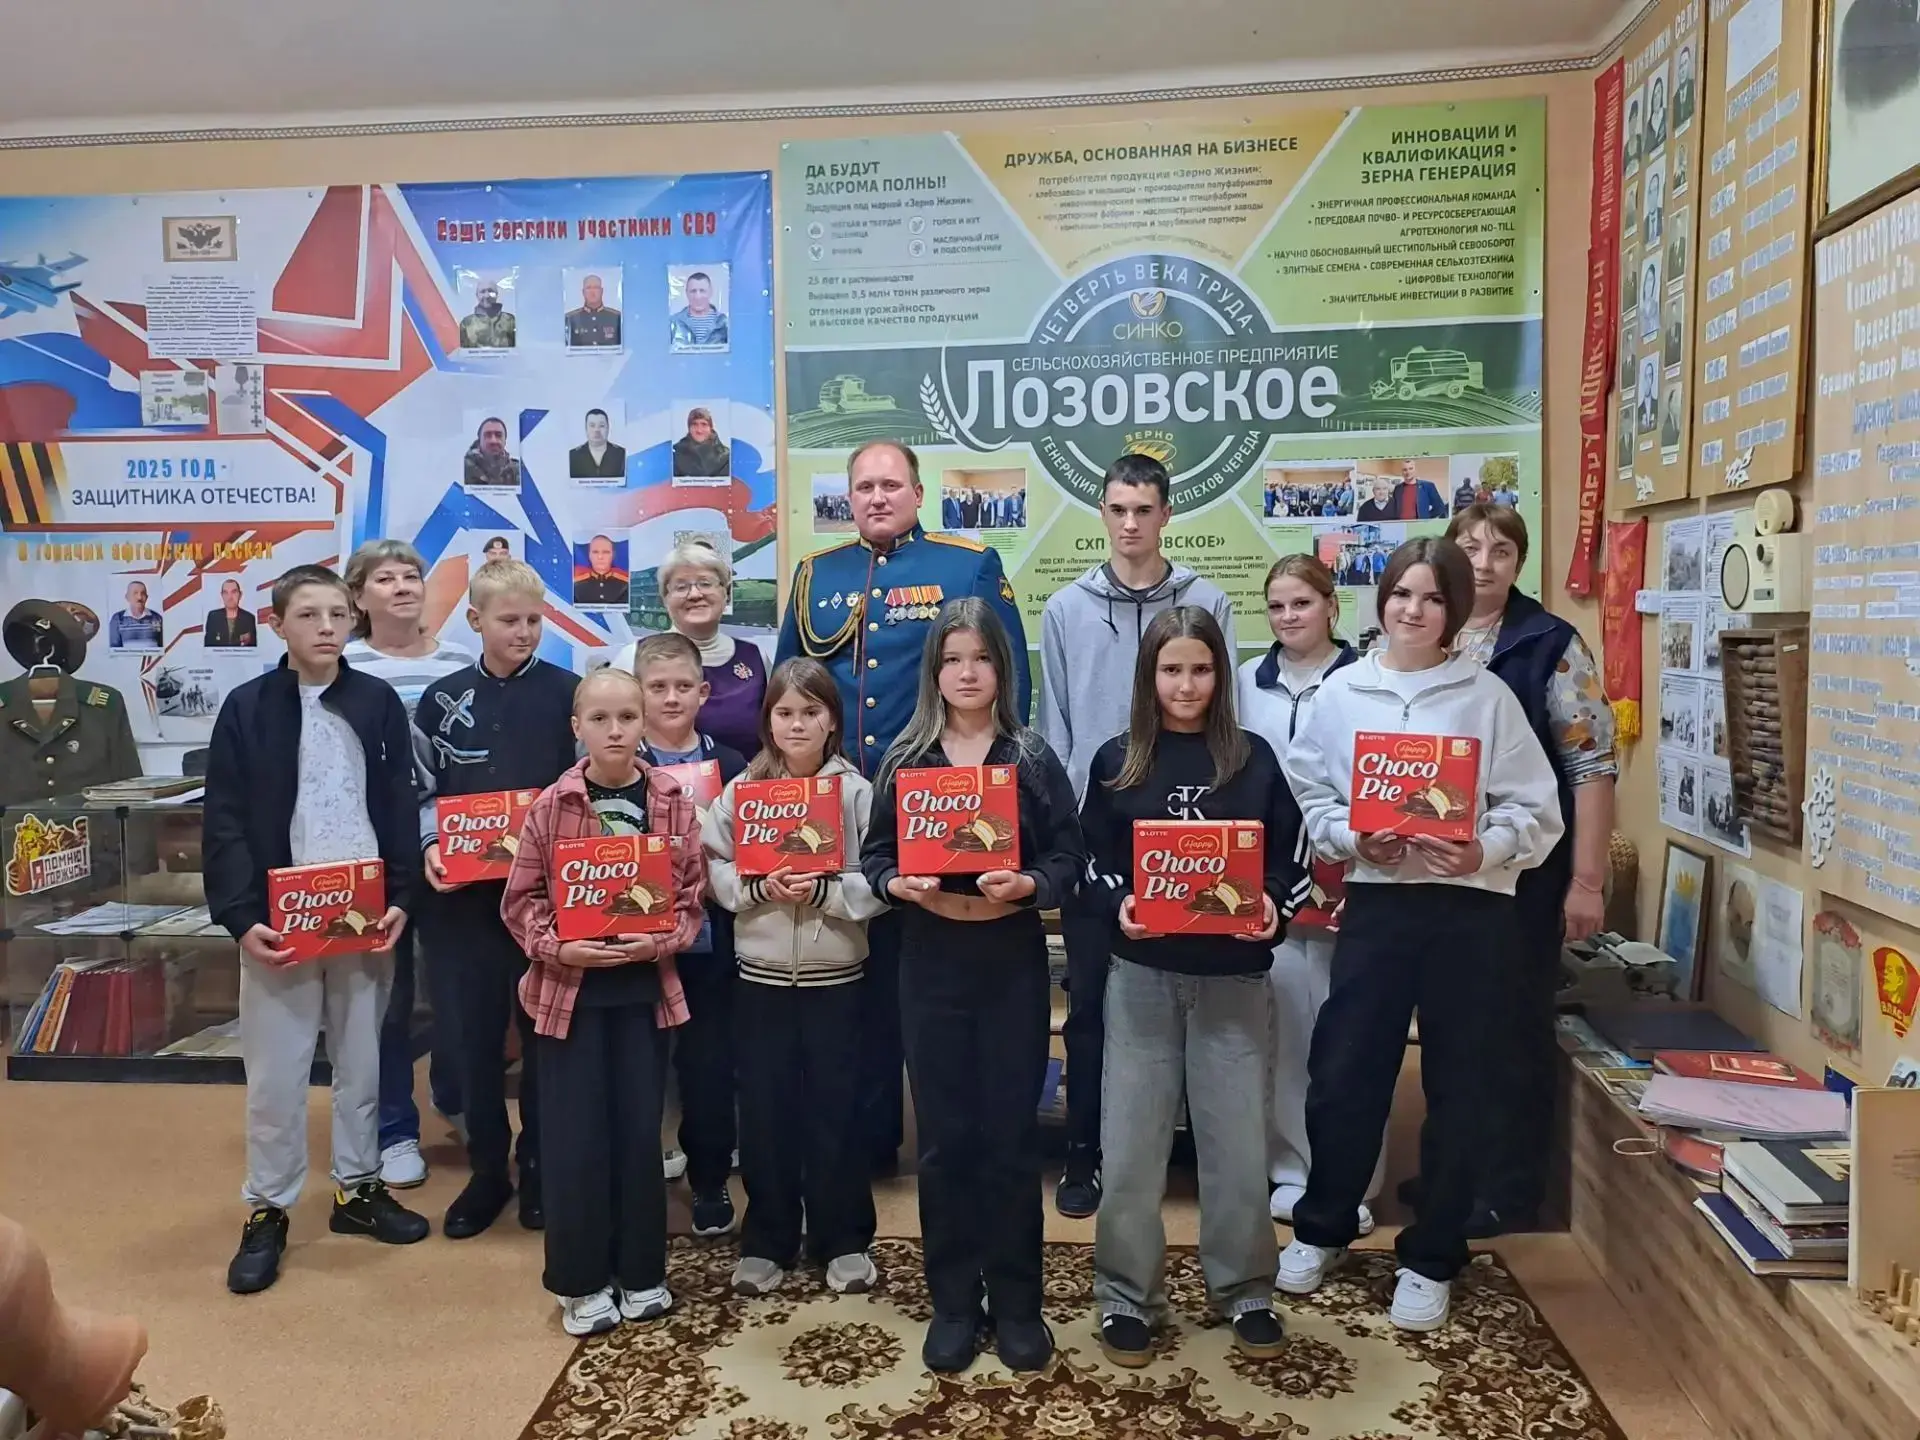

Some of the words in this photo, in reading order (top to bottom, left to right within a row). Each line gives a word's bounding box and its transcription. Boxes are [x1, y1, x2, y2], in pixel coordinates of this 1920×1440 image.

[1392, 125, 1499, 145] ИННОВАЦИИ
[1504, 124, 1517, 138] И
[1004, 150, 1078, 168] ДРУЖБА,
[1083, 143, 1192, 162] ОСНОВАННАЯ
[1197, 142, 1218, 156] НА
[1223, 137, 1298, 154] БИЗНЕСЕ
[1362, 144, 1505, 165] КВАЛИФИКАЦИЯ
[806, 165, 826, 179] ДА
[830, 162, 880, 176] БУДУТ
[1110, 170, 1170, 183] продукции
[1361, 169, 1414, 184] ЗЕРНА
[1419, 163, 1516, 181] ГЕНЕРАЦИЯ
[806, 179, 879, 195] ЗАКРОМА
[883, 176, 947, 192] ПОЛНЫ!
[1317, 198, 1374, 209] ЭНЕРГИЧНАЯ
[1376, 193, 1470, 206] ПРОФЕССИОНАЛЬНАЯ
[1471, 190, 1517, 202] КОМАНДА
[577, 215, 672, 241] участники
[682, 210, 717, 237] СВО
[1314, 214, 1365, 226] ПЕРЕДОВАЯ
[1403, 212, 1410, 221] И
[1412, 206, 1516, 220] РЕСУРСОСБЕРЕГАЮЩАЯ
[1400, 225, 1478, 237] АГРОТЕХНОЛОГИЯ
[1480, 222, 1515, 233] NO-TILL
[1273, 250, 1308, 259] НАУЧНО
[1310, 244, 1381, 257] ОБОСНОВАННЫЙ
[1383, 240, 1457, 254] ШЕСТИПОЛЬНЫЙ
[1459, 238, 1516, 250] СЕВООБОРОТ
[1283, 265, 1324, 275] ЭЛИТНЫЕ
[1326, 263, 1361, 273] СЕМЕНА
[1370, 259, 1434, 271] СОВРЕМЕННАЯ
[1435, 254, 1515, 267] СЕЛЬХОЗТЕХНИКА
[1405, 274, 1455, 285] ЦИФРОВЫЕ
[1458, 270, 1515, 282] ТЕХНОЛОГИИ
[1039, 271, 1127, 346] ЧЕТВЕРТЬ
[1134, 262, 1188, 285] ВЕКА
[1329, 292, 1397, 304] ЗНАЧИТЕЛЬНЫЕ
[1400, 289, 1459, 301] ИНВЕСТИЦИИ
[1461, 288, 1468, 298] В
[1470, 285, 1515, 296] РАЗВИТИЕ
[865, 303, 936, 317] урожайность
[919, 312, 980, 326] продукции
[1113, 320, 1184, 340] СИНКО
[1012, 348, 1214, 372] СЕЛЬСКОХОЗЯЙСТВЕННОЕ
[1218, 343, 1339, 366] ПРЕДПРИЯТИЕ
[1124, 430, 1175, 442] ЗЕРНО
[127, 459, 173, 479] 2025
[180, 458, 216, 480] ГОД
[1041, 435, 1098, 497] ГЕНЕРАЦИЯ
[1168, 472, 1225, 506] УСПЕХОВ
[1222, 429, 1262, 475] ЧЕРЕДА
[72, 487, 196, 508] ЗАЩИТНИКА
[201, 486, 316, 505] ОТЕЧЕСТВА!
[1075, 537, 1105, 550] СХП
[1358, 752, 1439, 779] Choco
[1356, 777, 1402, 802] Pie
[738, 799, 809, 822] Choco
[901, 789, 982, 813] Choco
[442, 813, 510, 833] Choco
[739, 823, 778, 845] Pie
[902, 816, 948, 840] Pie
[444, 834, 483, 856] Pie
[560, 860, 639, 883] Choco
[1140, 850, 1226, 875] Choco
[31, 859, 45, 890] Я
[562, 884, 608, 909] Pie
[1142, 876, 1190, 900] Pie
[278, 889, 353, 912] Choco
[280, 912, 322, 935] Pie
